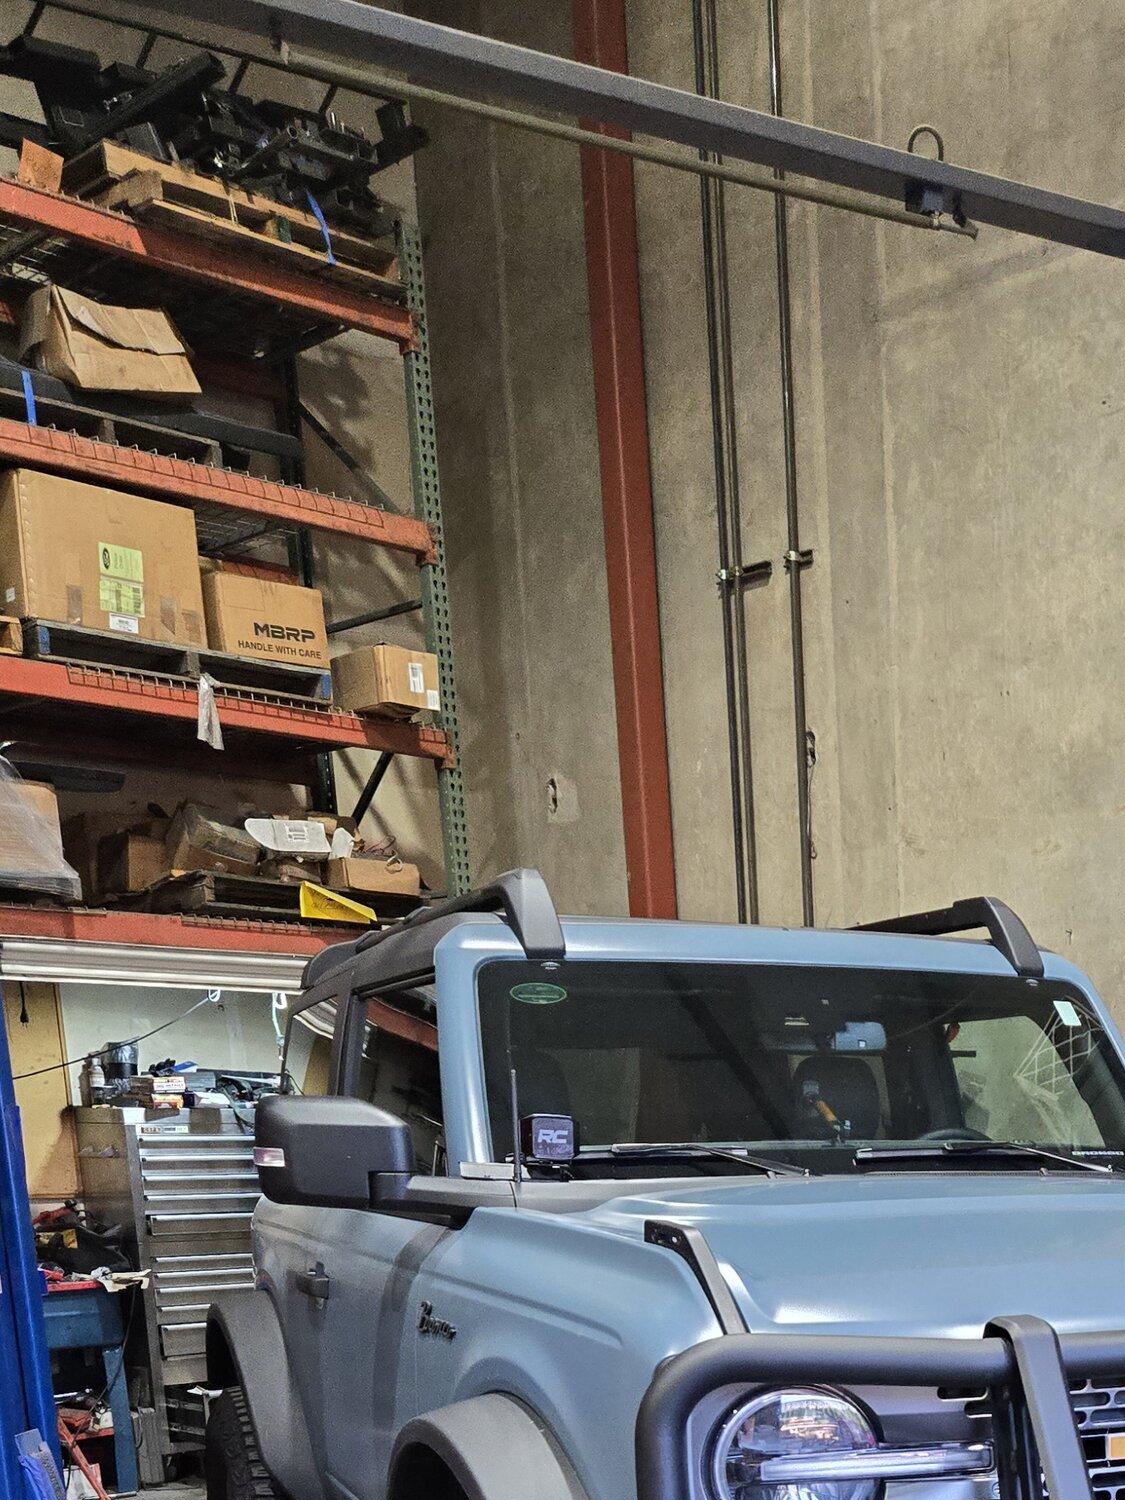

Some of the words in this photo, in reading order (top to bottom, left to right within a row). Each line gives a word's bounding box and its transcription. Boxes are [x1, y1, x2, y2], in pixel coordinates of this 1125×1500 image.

[253, 622, 316, 643] MBRP
[237, 640, 274, 653] HANDLE
[275, 645, 297, 656] WITH
[298, 649, 322, 660] CARE
[537, 1129, 569, 1144] RC
